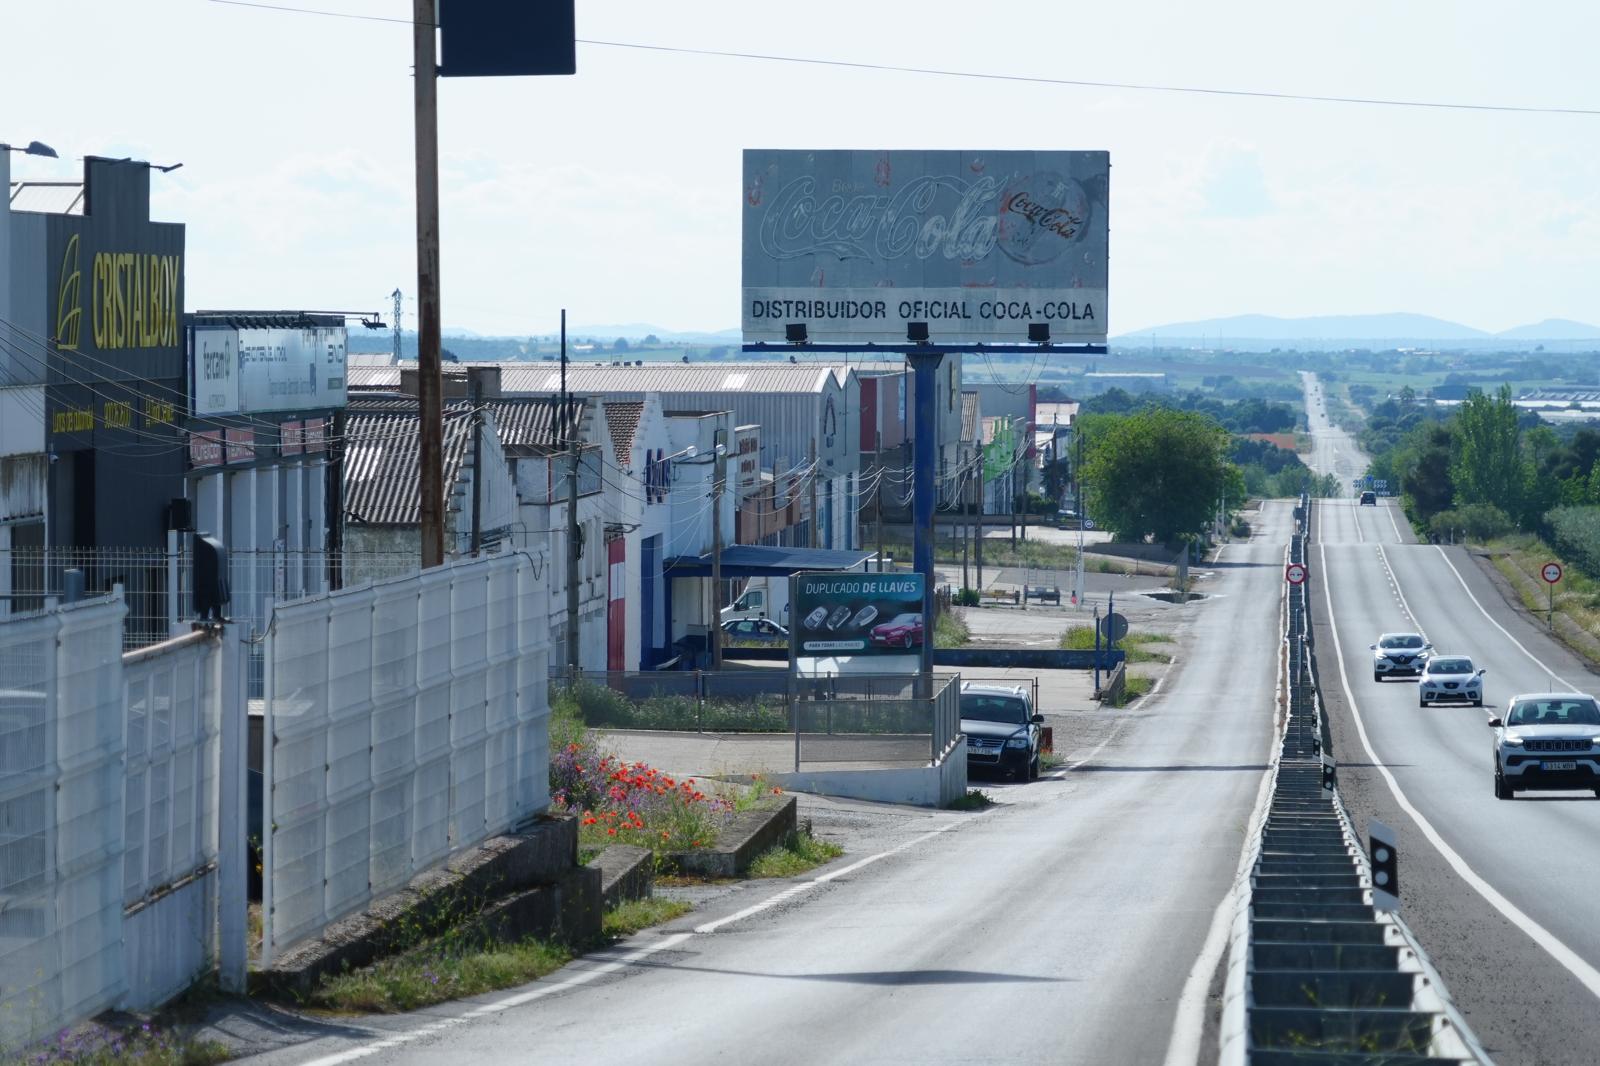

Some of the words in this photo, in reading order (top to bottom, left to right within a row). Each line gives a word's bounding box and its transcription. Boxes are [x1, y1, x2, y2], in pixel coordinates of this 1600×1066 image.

[92, 252, 180, 349] CRISTALBOX
[752, 300, 887, 320] DISTRIBUIDOR
[899, 300, 971, 320] OFICIAL
[979, 301, 1095, 321] COCA-COLA
[805, 582, 860, 594] DUPLICADO
[862, 582, 876, 593] DE
[878, 581, 916, 593] LLAVES
